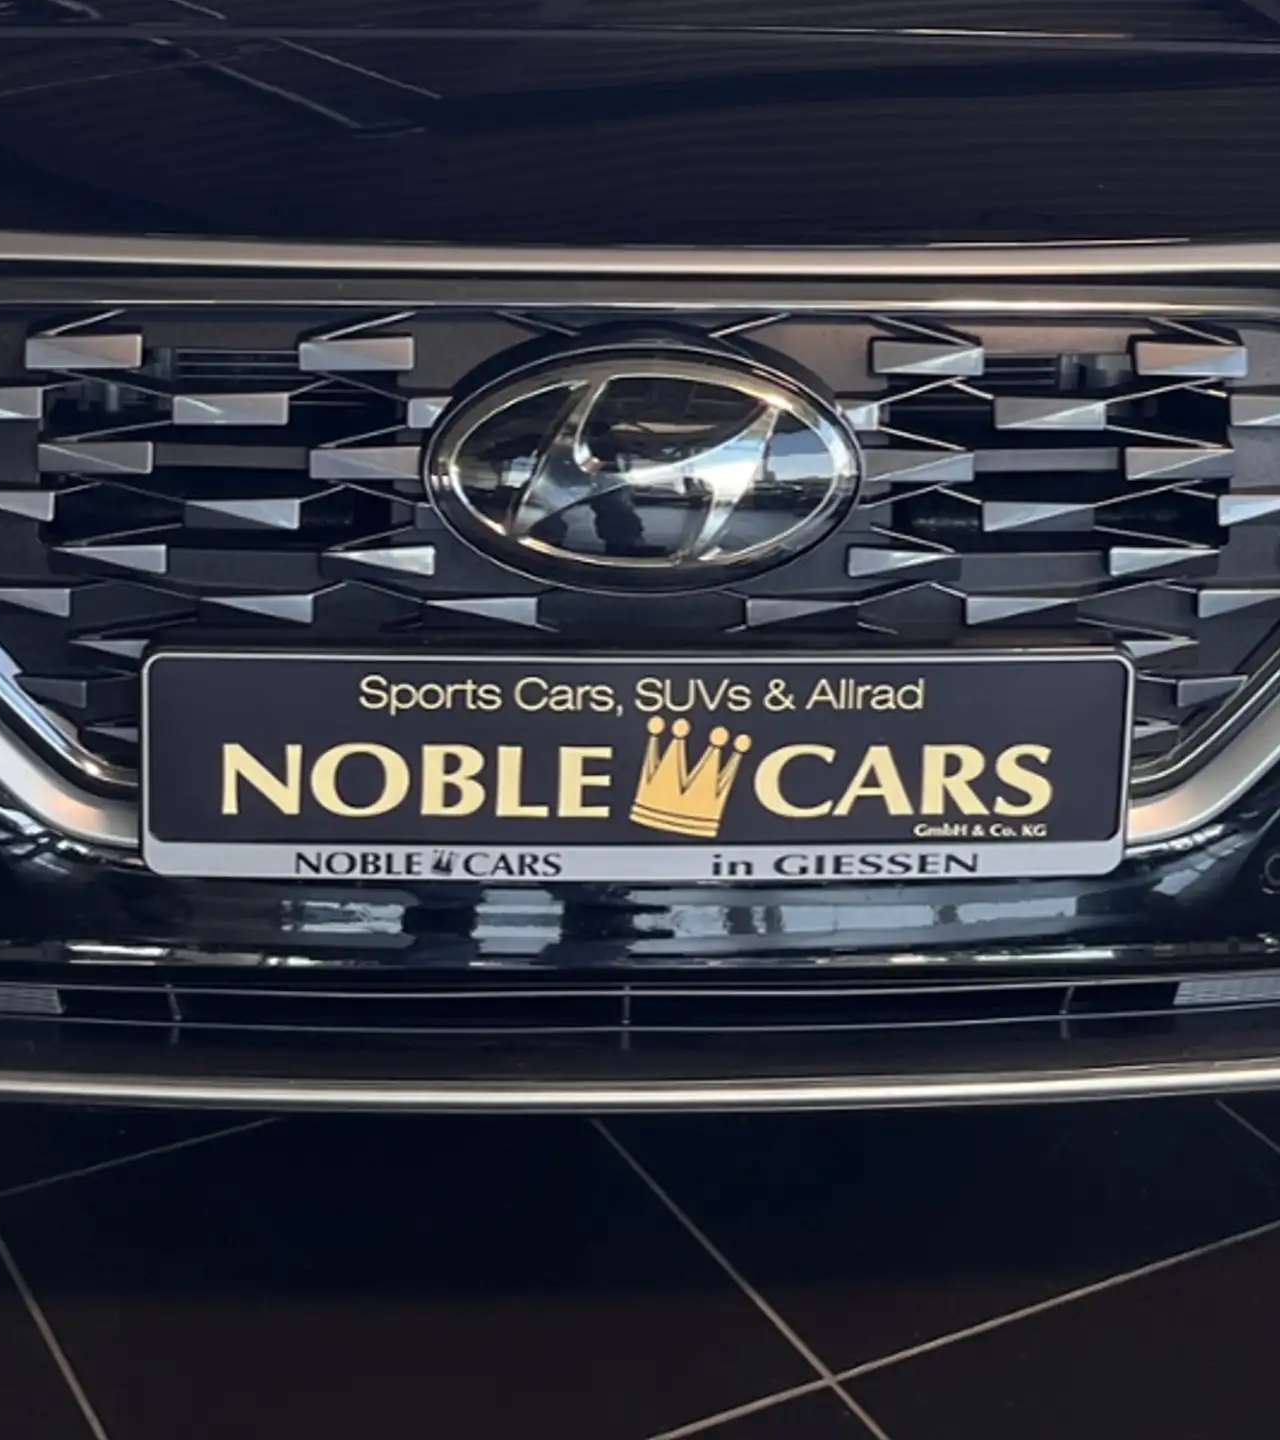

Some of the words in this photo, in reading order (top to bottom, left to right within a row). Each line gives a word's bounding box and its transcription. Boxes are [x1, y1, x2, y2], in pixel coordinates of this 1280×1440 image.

[358, 674, 503, 717] Sports
[513, 676, 624, 717] Cars,
[633, 677, 752, 712] SUVs
[762, 678, 796, 712] &
[803, 677, 926, 711] Allrad
[221, 742, 614, 819] NOBLE
[753, 742, 1054, 818] CARS
[913, 822, 969, 837] GmbH
[988, 822, 1018, 837] Co.
[1021, 823, 1048, 837] KG
[294, 850, 423, 876] NOBLE
[462, 851, 562, 877] CARS
[712, 854, 754, 876] in
[771, 853, 979, 876] GIESSEN
